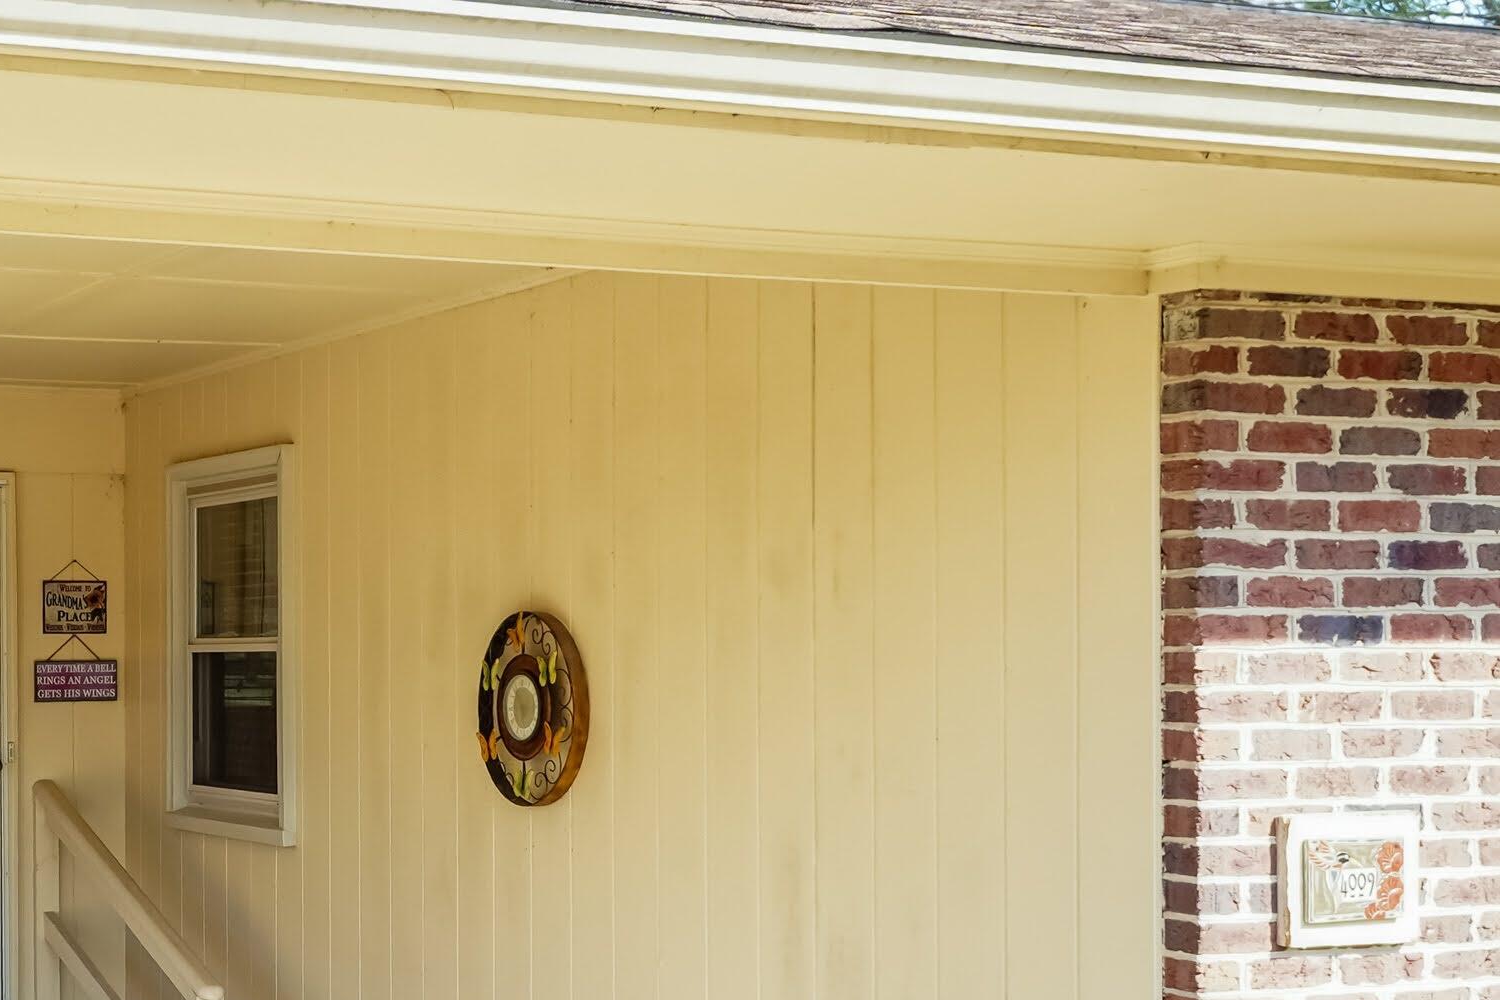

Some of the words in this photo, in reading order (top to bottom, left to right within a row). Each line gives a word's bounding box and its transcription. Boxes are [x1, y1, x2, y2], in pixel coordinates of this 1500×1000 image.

[46, 592, 88, 609] GRANDMA'S
[57, 610, 92, 622] PLACE
[37, 664, 63, 673] EVERY
[64, 664, 86, 673] TIME
[86, 664, 94, 673] A
[95, 664, 116, 673] BELL
[37, 676, 66, 685] RINGS
[68, 676, 81, 685] AN
[83, 675, 116, 684] ANGEL
[37, 689, 62, 698] GETS
[64, 689, 81, 698] HIS
[82, 689, 116, 698] WINGS
[1340, 872, 1375, 897] 4009
